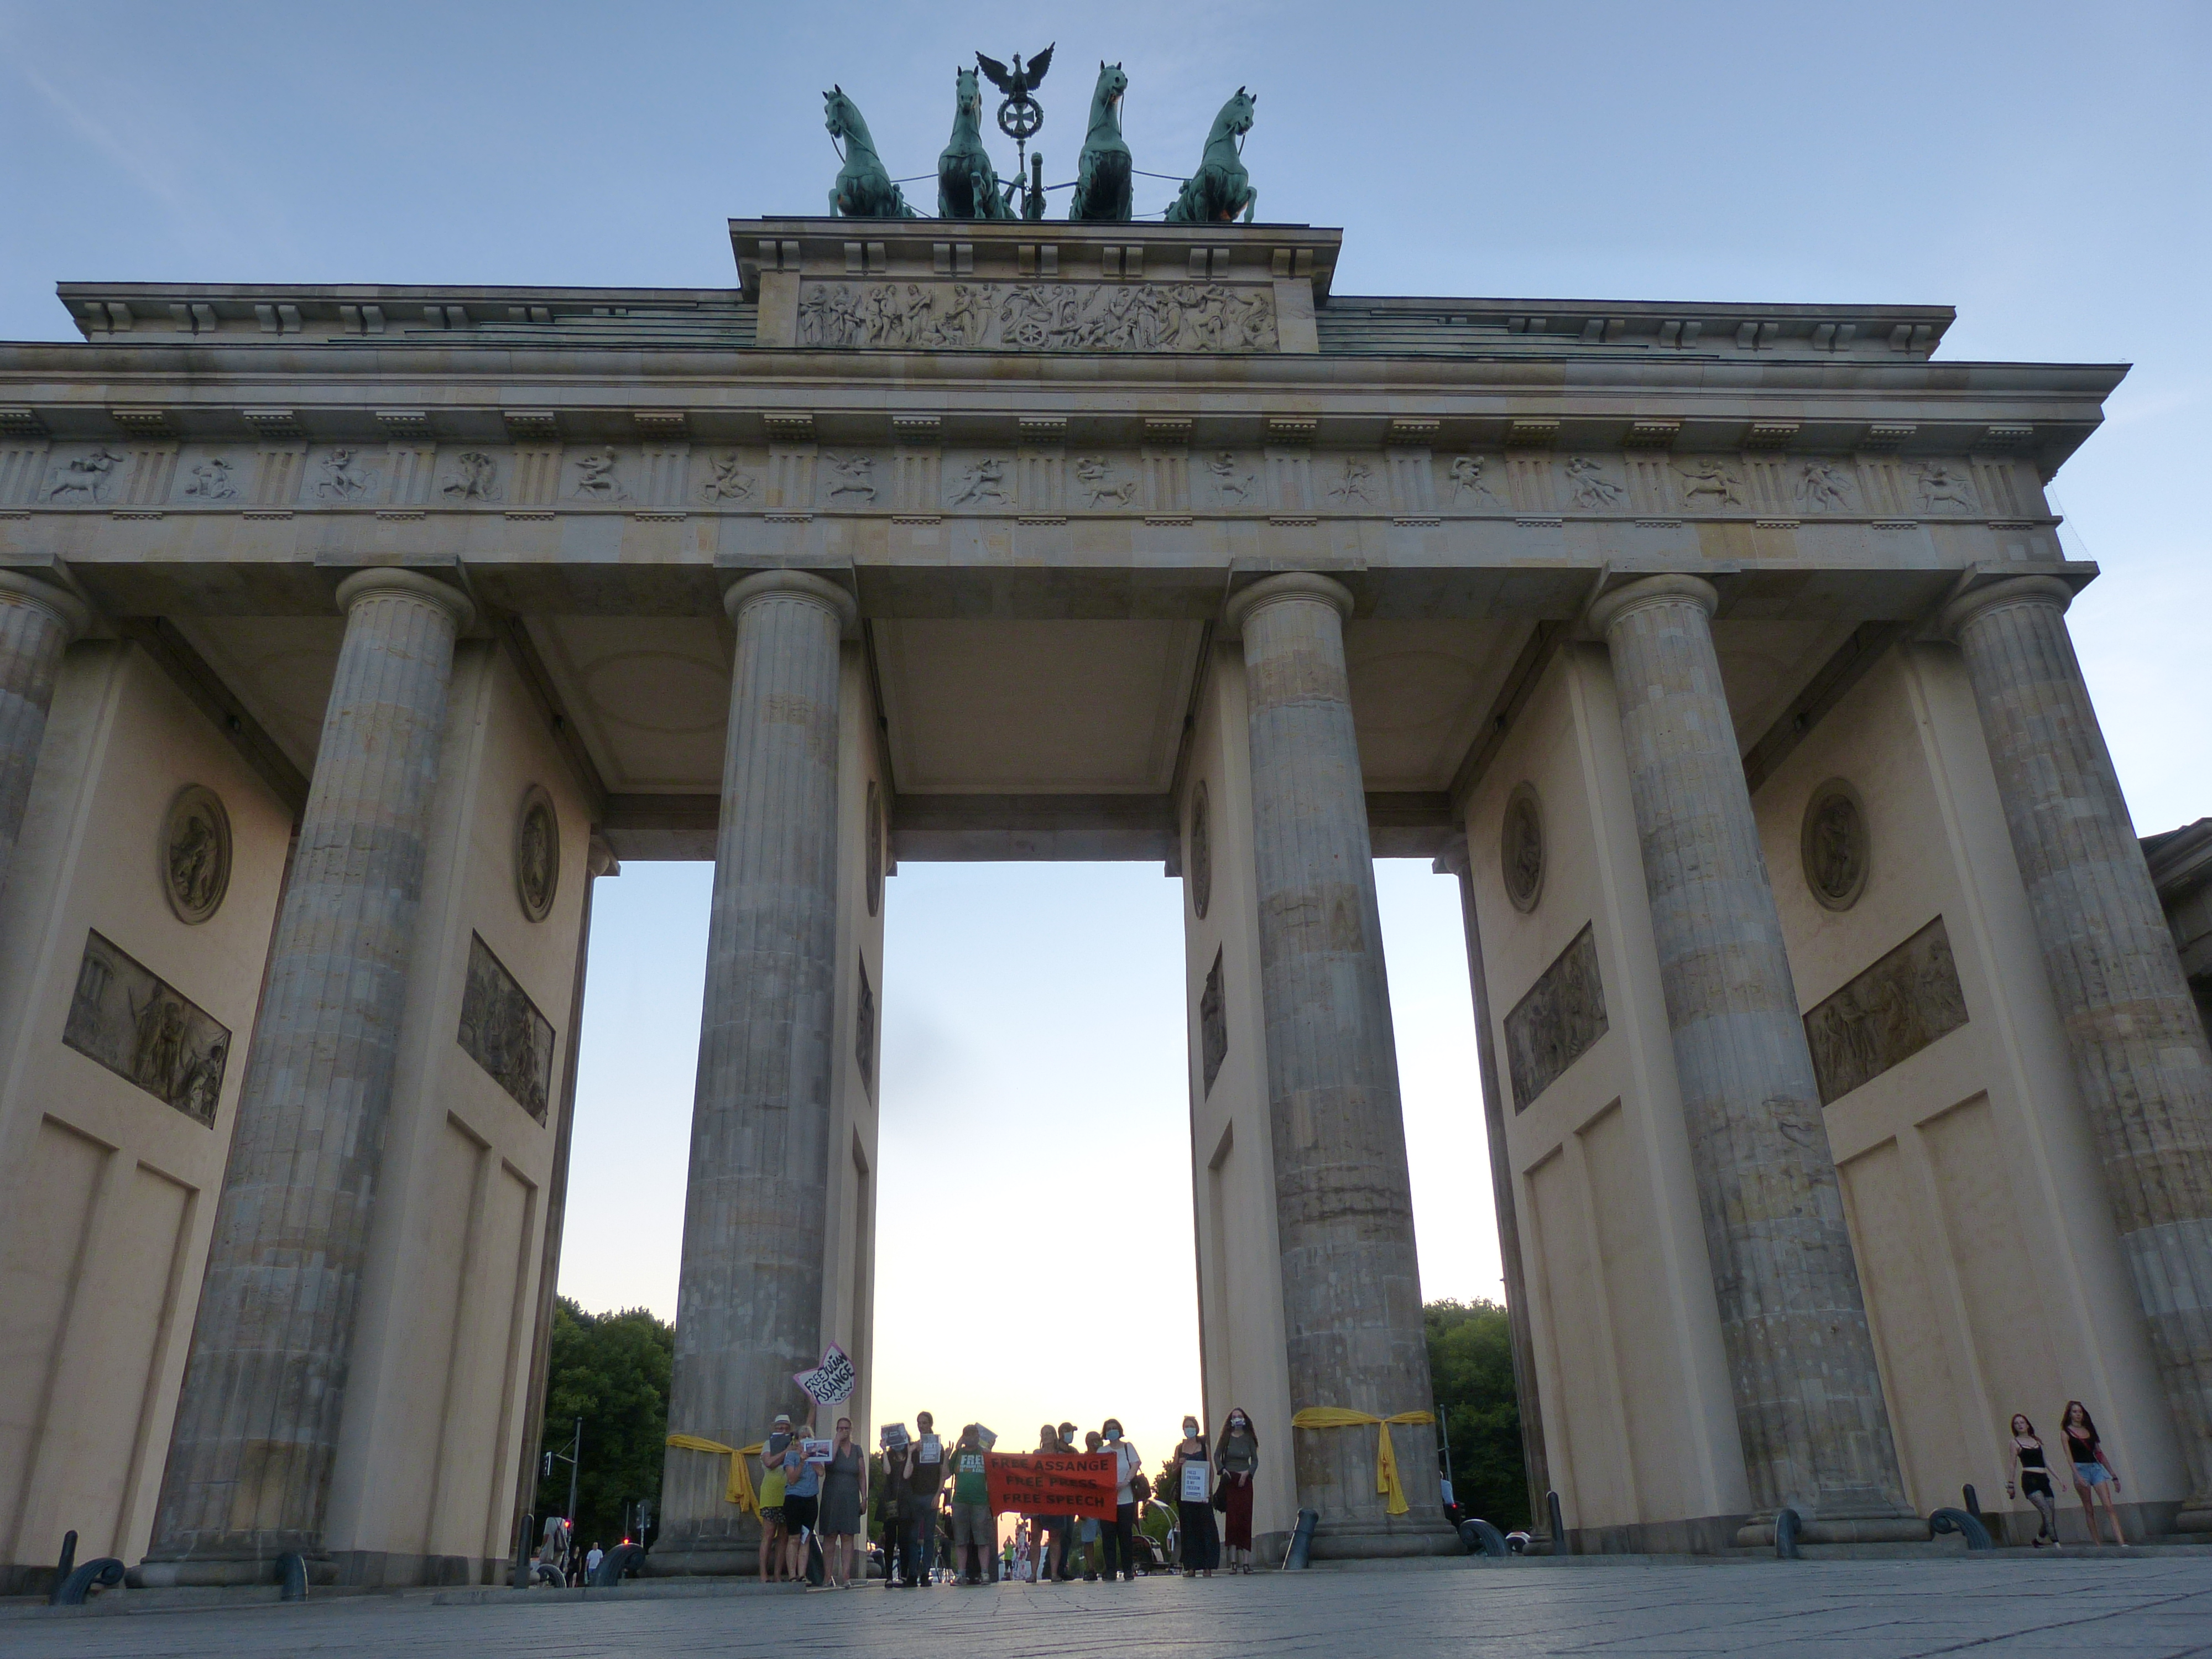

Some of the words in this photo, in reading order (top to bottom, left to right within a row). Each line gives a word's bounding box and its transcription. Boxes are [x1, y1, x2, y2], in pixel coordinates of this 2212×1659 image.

[804, 1371, 825, 1394] FREE
[813, 1363, 855, 1405] ASSANGE
[834, 1381, 853, 1402] NOW
[992, 1458, 1029, 1469] FREE
[1034, 1459, 1109, 1472] ASSANGE
[1006, 1475, 1044, 1488] FREE
[1050, 1477, 1098, 1490] PRESS
[1003, 1494, 1041, 1504] FREE
[1046, 1495, 1104, 1507] SPEECH
